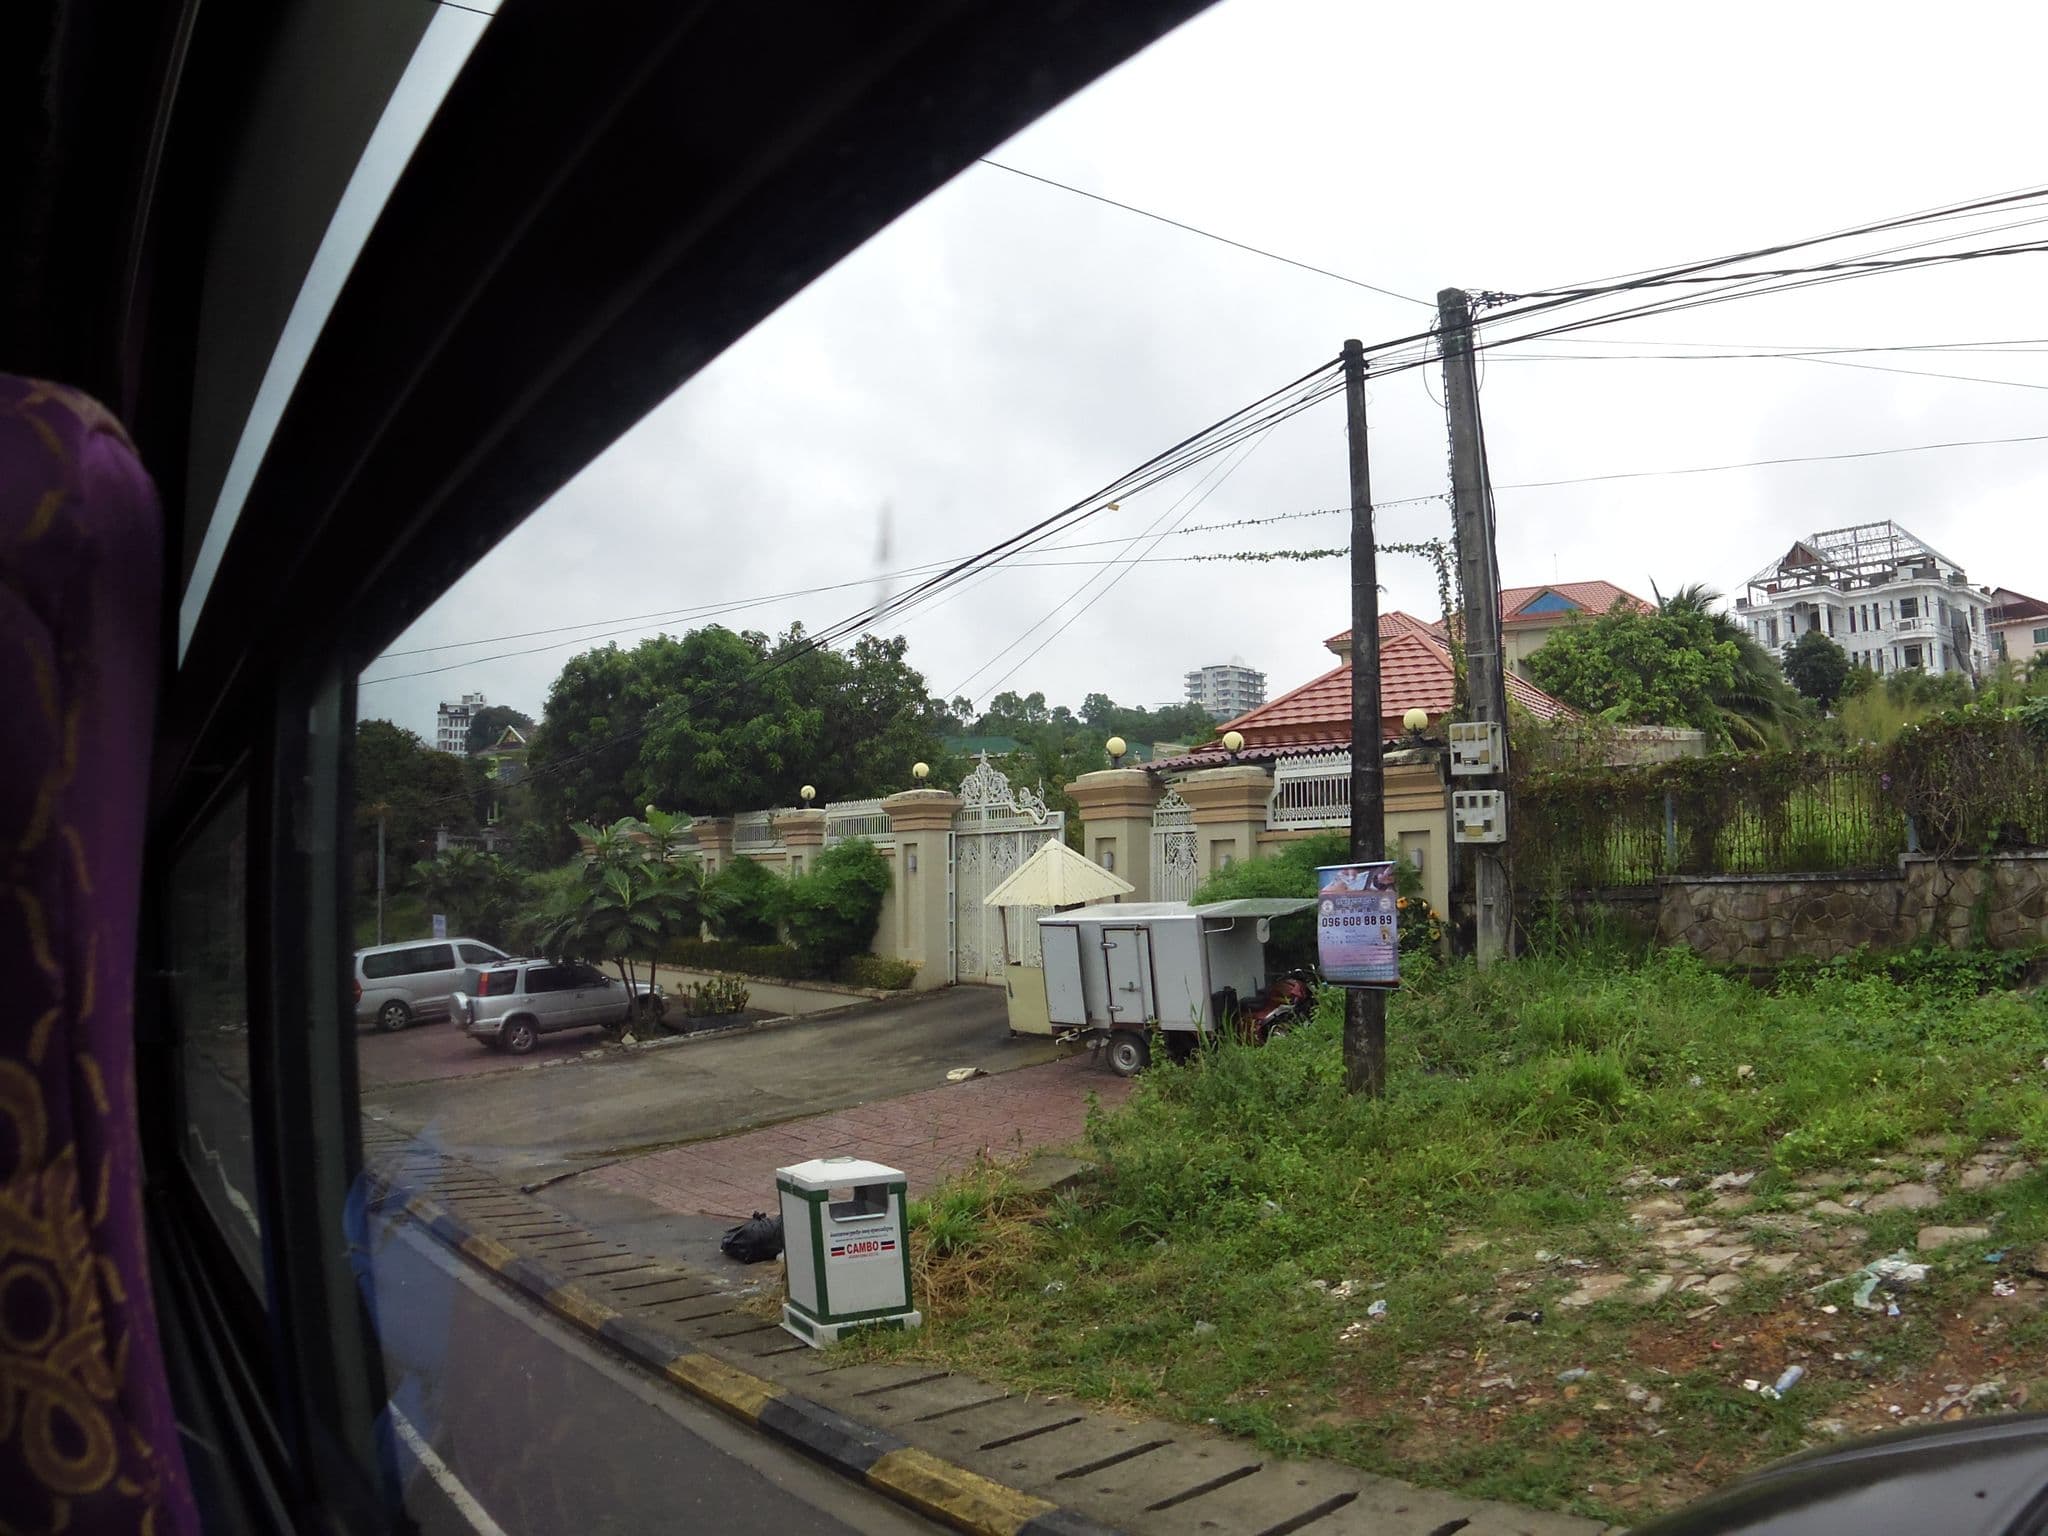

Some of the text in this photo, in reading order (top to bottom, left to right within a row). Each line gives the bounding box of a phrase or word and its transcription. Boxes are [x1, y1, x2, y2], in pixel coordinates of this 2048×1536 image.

[1322, 915, 1392, 927] 096 608 88 89
[846, 1241, 879, 1254] CAMBO
